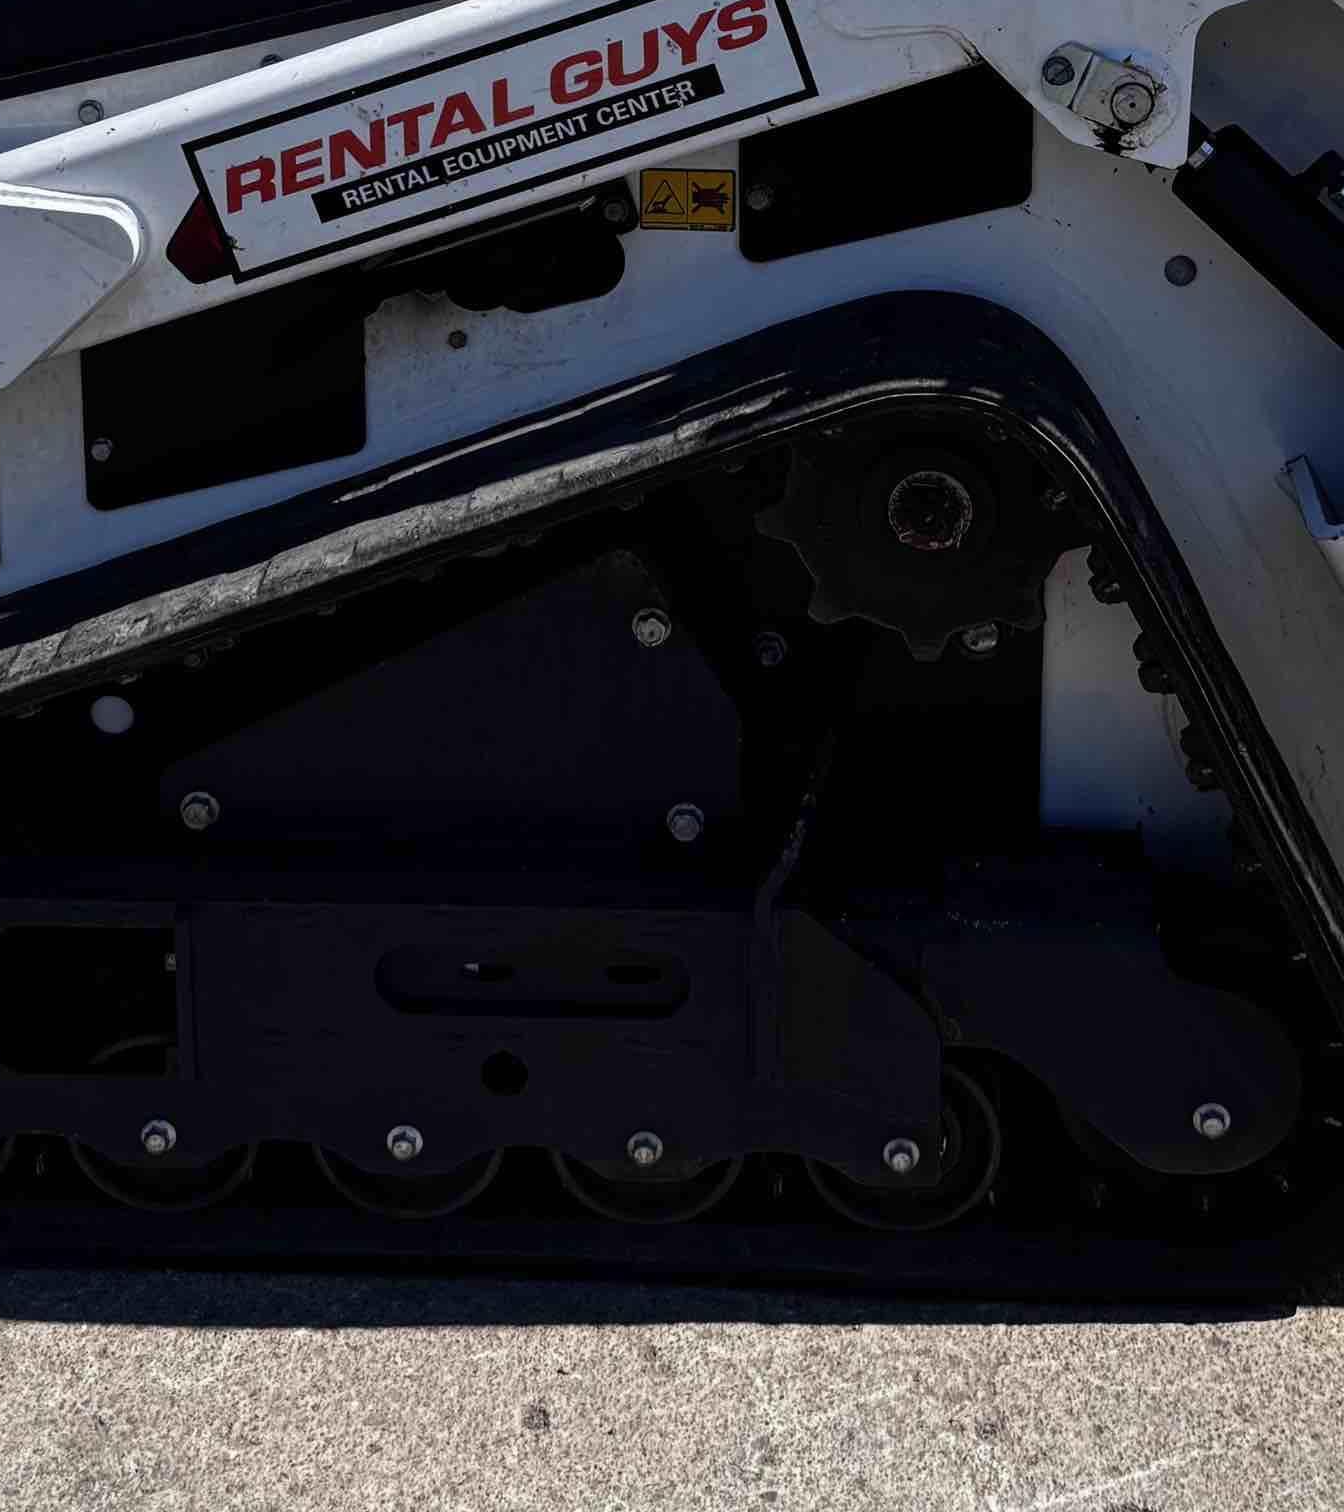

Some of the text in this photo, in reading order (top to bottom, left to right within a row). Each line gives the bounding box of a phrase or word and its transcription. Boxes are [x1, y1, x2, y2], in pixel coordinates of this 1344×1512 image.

[225, 77, 535, 216] RENTAL
[341, 79, 697, 210] RENTAL EQUIPMENT CENTER
